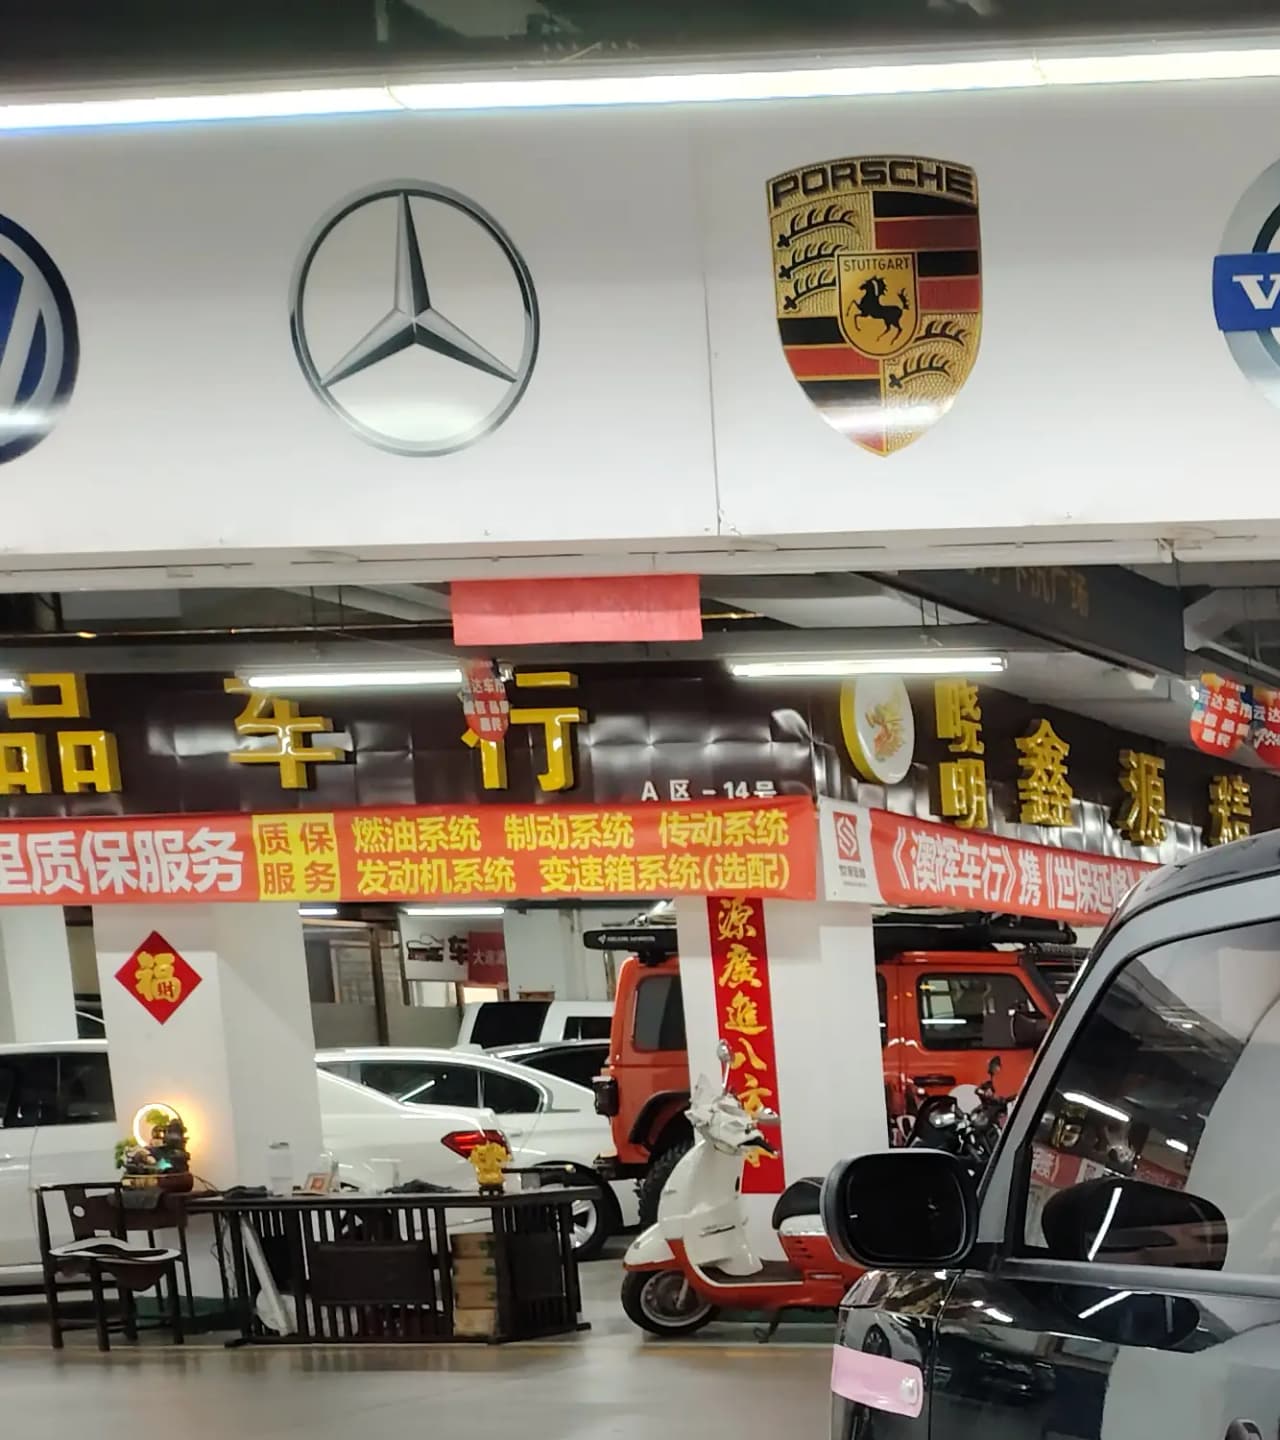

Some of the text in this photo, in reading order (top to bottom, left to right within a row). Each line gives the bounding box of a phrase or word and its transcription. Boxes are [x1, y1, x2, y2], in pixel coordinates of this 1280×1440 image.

[772, 160, 974, 208] PORSCHE
[843, 257, 911, 272] STUTTGART
[257, 822, 334, 857] 质保
[351, 808, 790, 854] 燃油系统 制动系统 传动系统
[262, 862, 338, 896] 服务
[356, 857, 517, 895] 发动机系统
[134, 951, 182, 1003] 福
[718, 898, 779, 1168] 源廣進八方
